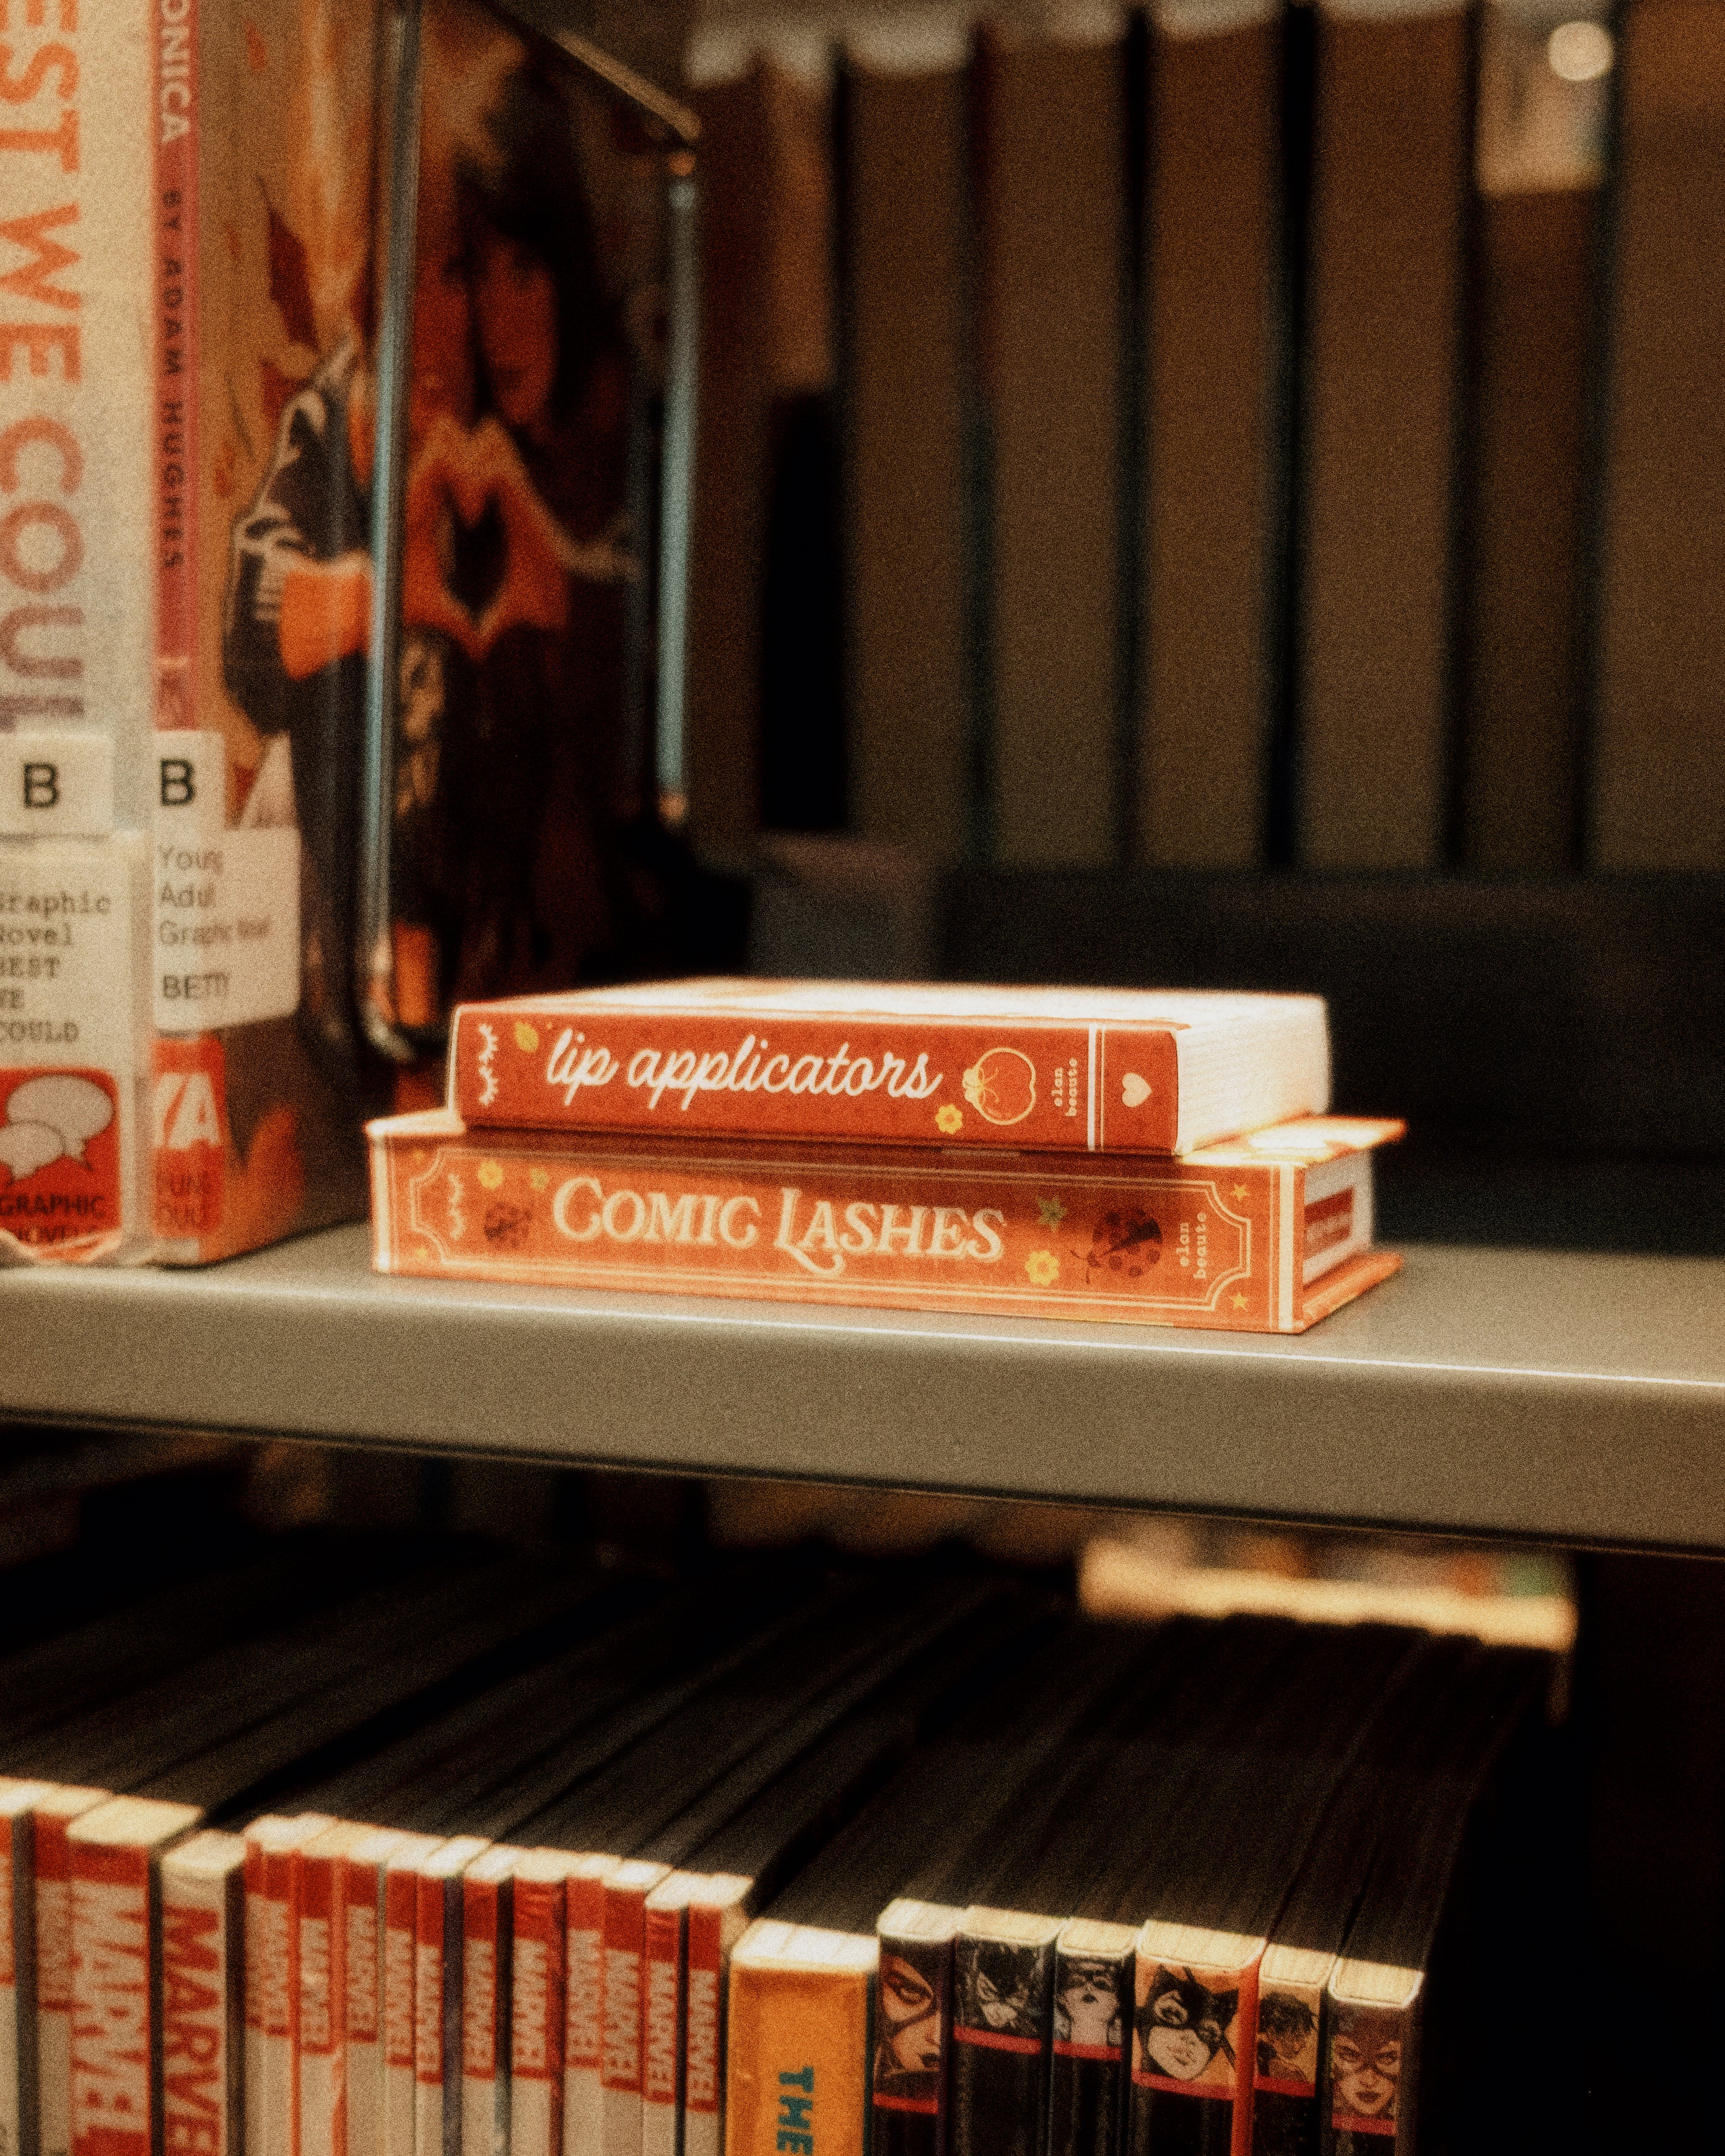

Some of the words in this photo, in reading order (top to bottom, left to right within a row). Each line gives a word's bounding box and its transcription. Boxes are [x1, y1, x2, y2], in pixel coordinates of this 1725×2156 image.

[162, 189, 183, 230] BY
[0, 203, 82, 385] WE
[162, 255, 184, 374] ADAM
[162, 401, 185, 567] HUGHES
[23, 761, 60, 808] B
[160, 759, 197, 806] B
[546, 1027, 619, 1106] lip
[627, 1033, 943, 1111] applicators
[552, 1176, 763, 1249] COMIC
[774, 1187, 1008, 1277] LASHES
[71, 1879, 147, 2139] MARVEL
[347, 1904, 375, 2036] MARVEL
[386, 1928, 413, 2060] MARVEL
[464, 1938, 494, 2074] MARVEL
[513, 1937, 546, 2071] MARVEL
[567, 1928, 599, 2062] MARVEL
[603, 1949, 641, 2083] MARVEL
[647, 1959, 676, 2098] MARVEL
[688, 1968, 717, 2106] MARVEL
[777, 2066, 814, 2155] THE
